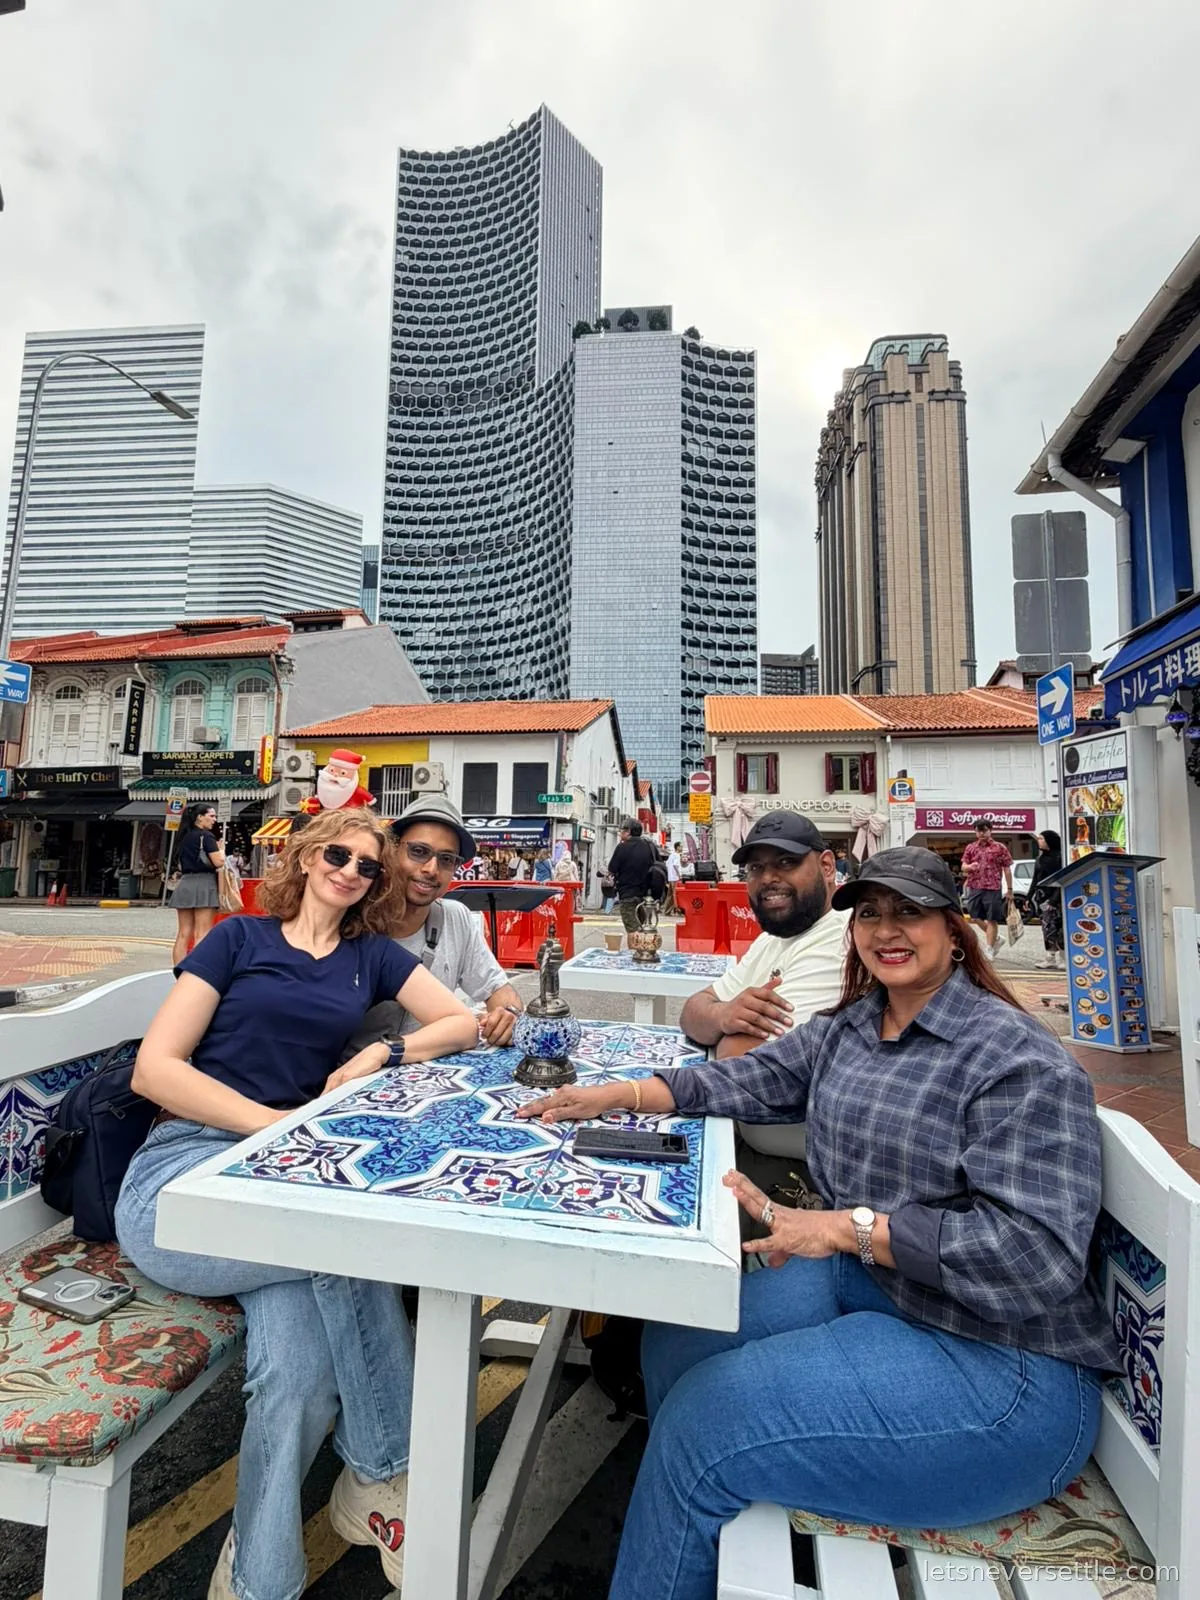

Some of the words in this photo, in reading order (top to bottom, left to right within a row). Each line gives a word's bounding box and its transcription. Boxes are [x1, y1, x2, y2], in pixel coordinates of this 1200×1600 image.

[1121, 642, 1200, 707] トルコ料理
[8, 687, 25, 699] WAY
[128, 691, 140, 751] CARPETS
[1041, 720, 1056, 738] ONE
[1056, 712, 1072, 732] WAY
[162, 752, 197, 760] SARVAN'S
[199, 751, 234, 760] CARPETS
[35, 772, 54, 783] The
[55, 771, 89, 785] Fluffy
[91, 771, 116, 783] Chef
[542, 794, 560, 802] Arab
[562, 794, 570, 802] St
[760, 799, 853, 811] TUDUNGPEOPLE
[465, 817, 511, 828] SG
[984, 812, 1027, 826] Designs
